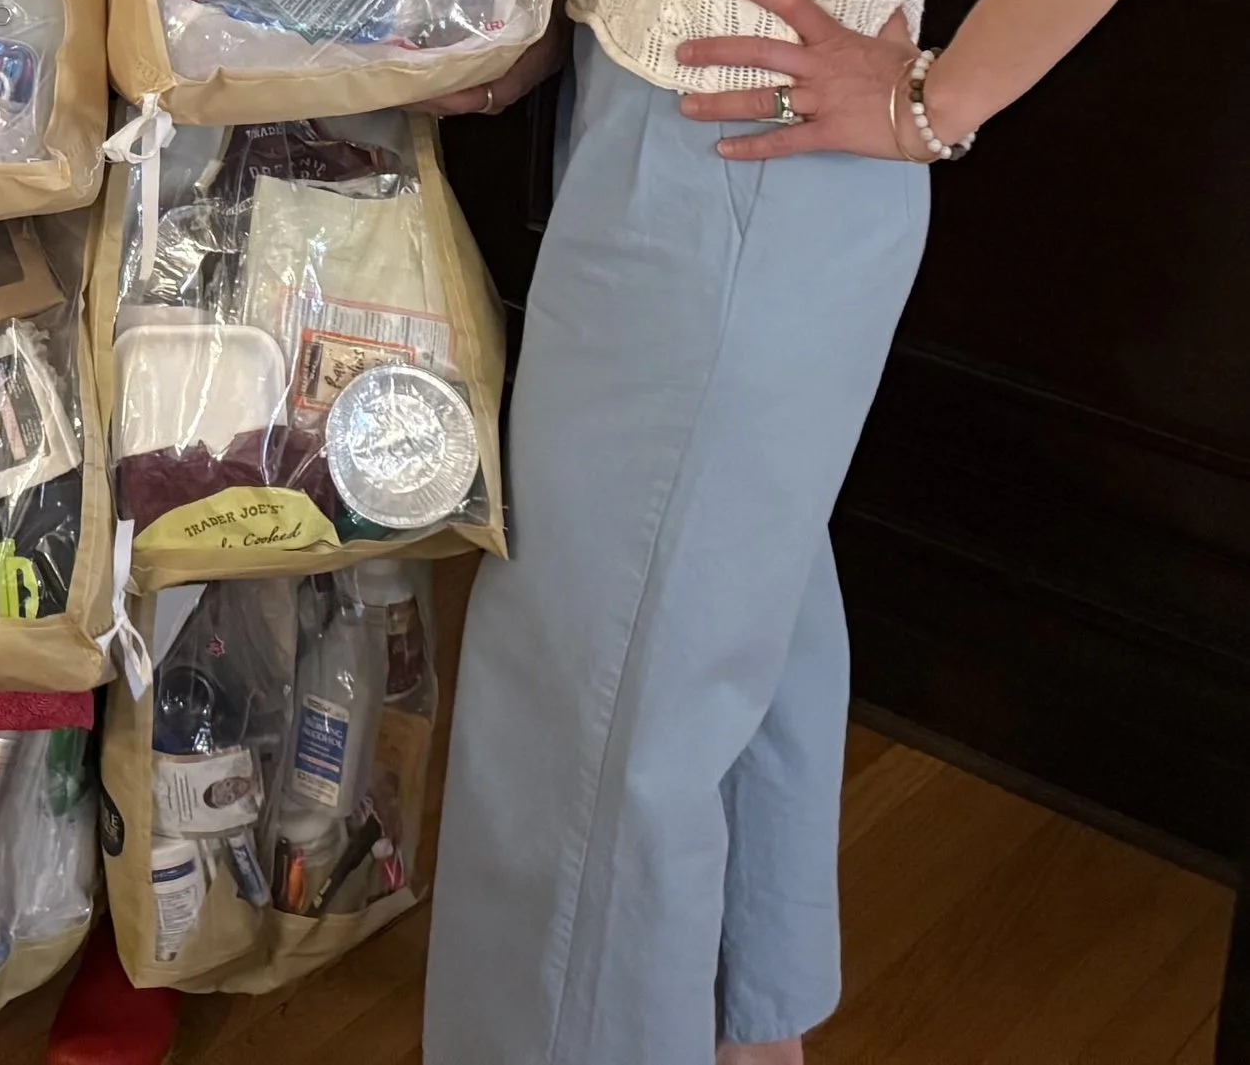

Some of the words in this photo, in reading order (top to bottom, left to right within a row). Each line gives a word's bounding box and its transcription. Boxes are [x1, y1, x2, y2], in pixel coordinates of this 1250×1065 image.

[184, 512, 236, 538] TRADER
[240, 503, 279, 519] JOE'S
[243, 521, 302, 547] Cooked
